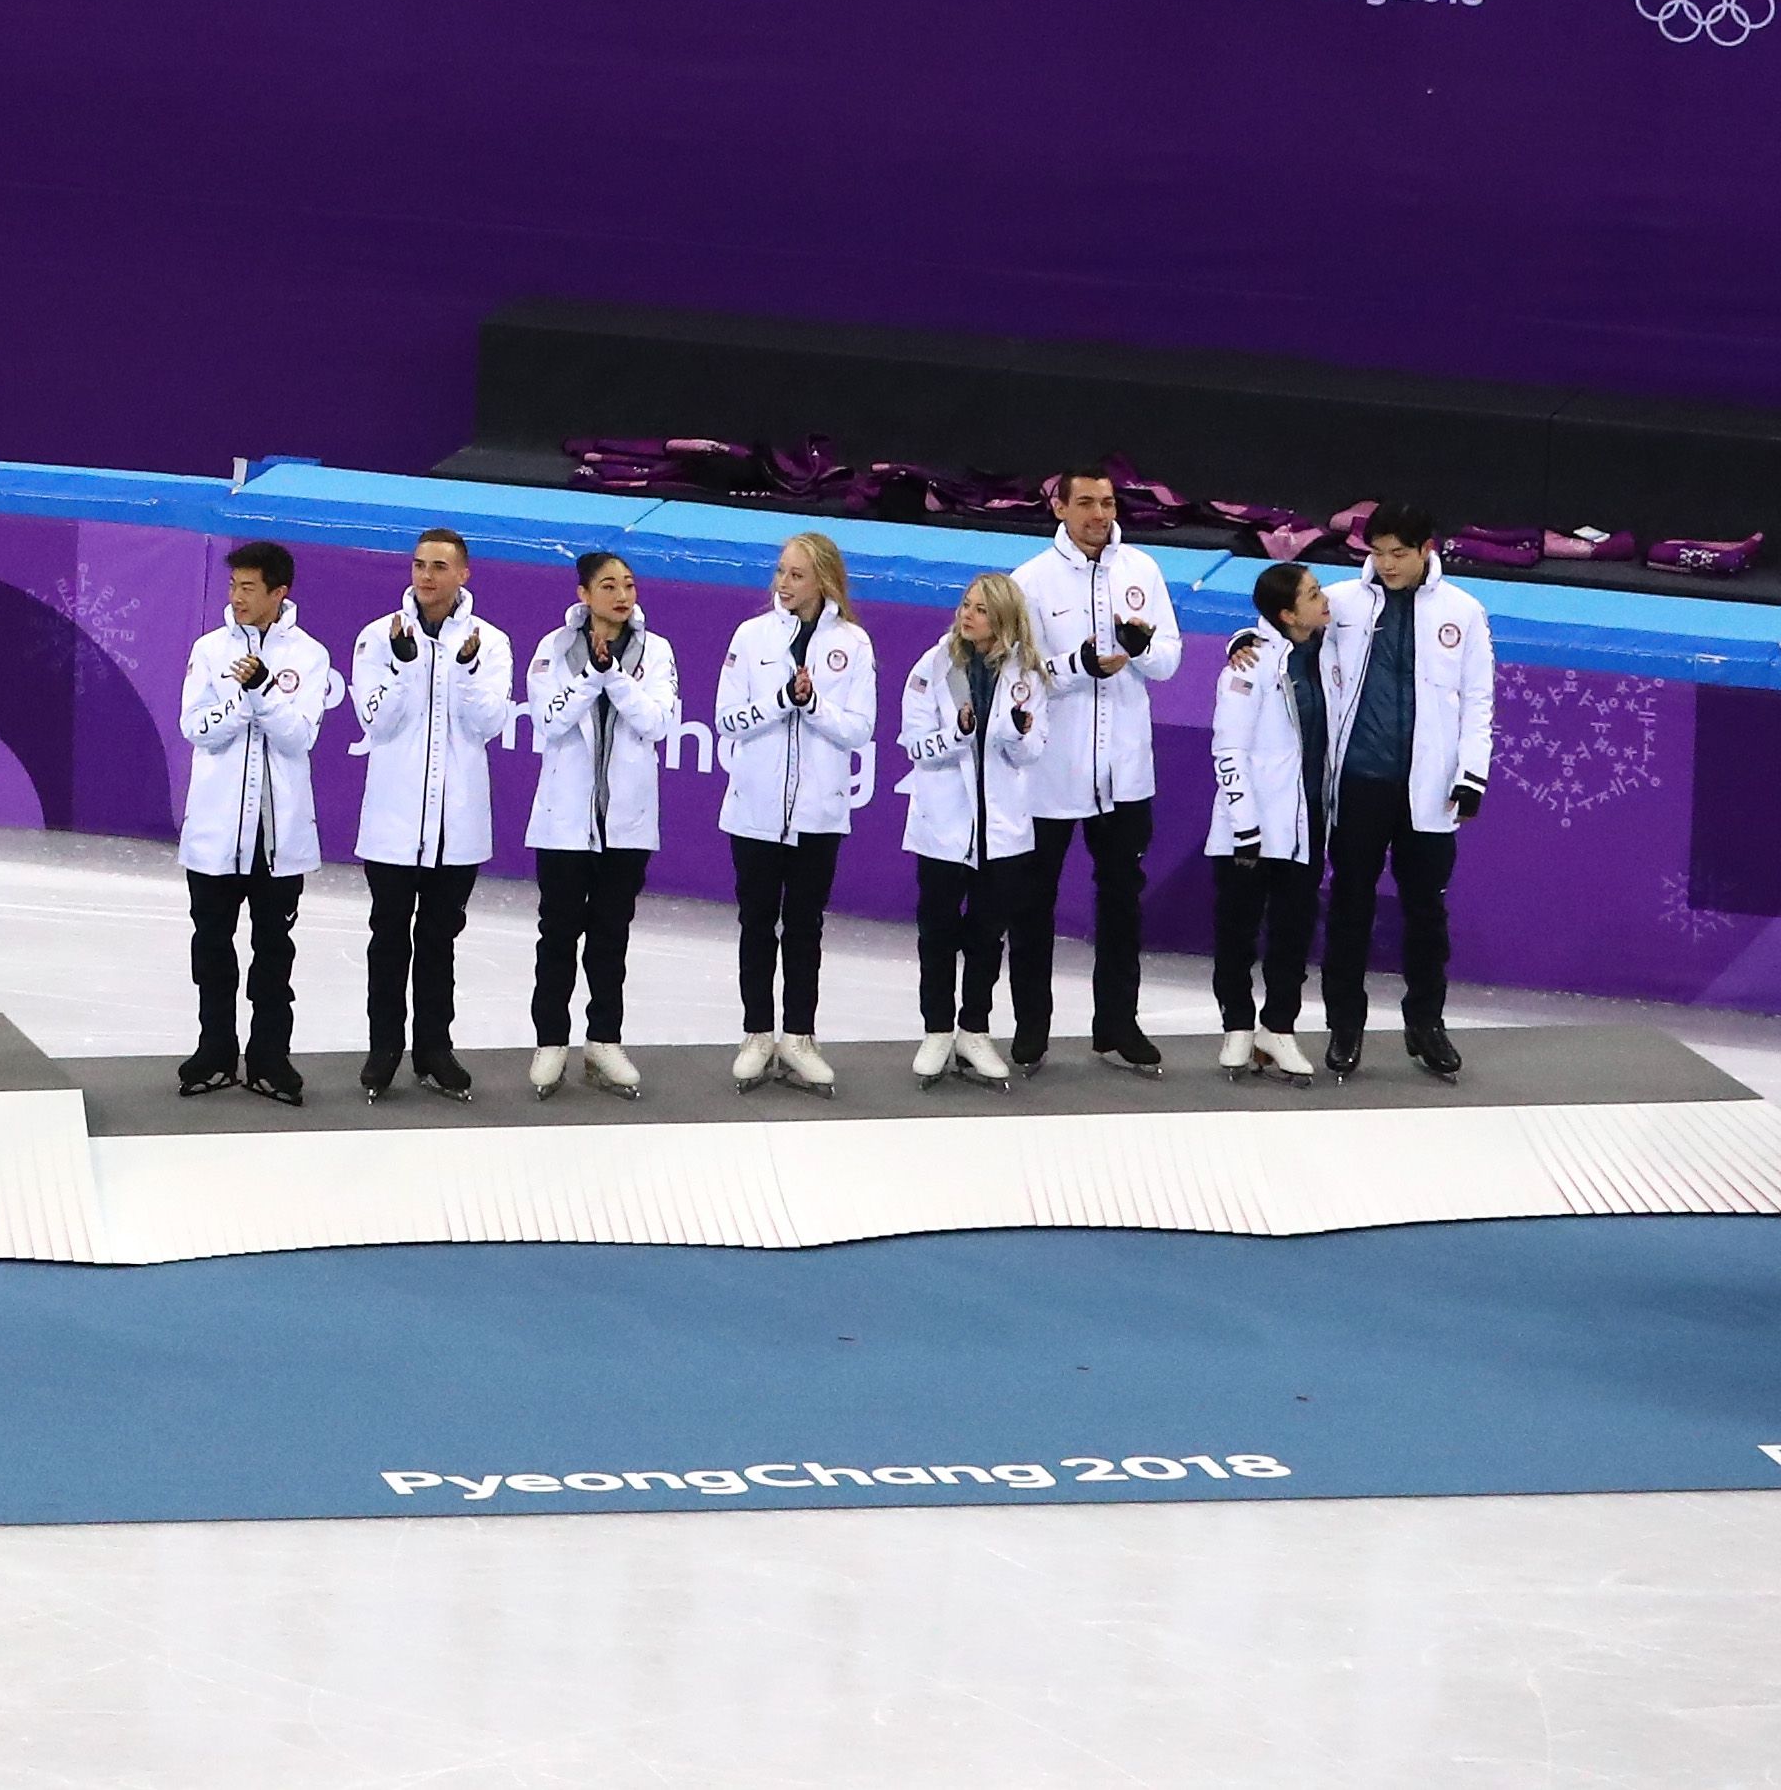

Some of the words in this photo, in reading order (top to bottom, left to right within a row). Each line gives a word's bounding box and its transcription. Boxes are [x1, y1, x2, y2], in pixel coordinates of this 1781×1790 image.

[722, 705, 765, 733] USA
[909, 733, 949, 761] USA
[380, 1456, 1057, 1500] PyeongChang
[1060, 1454, 1292, 1481] 2018
